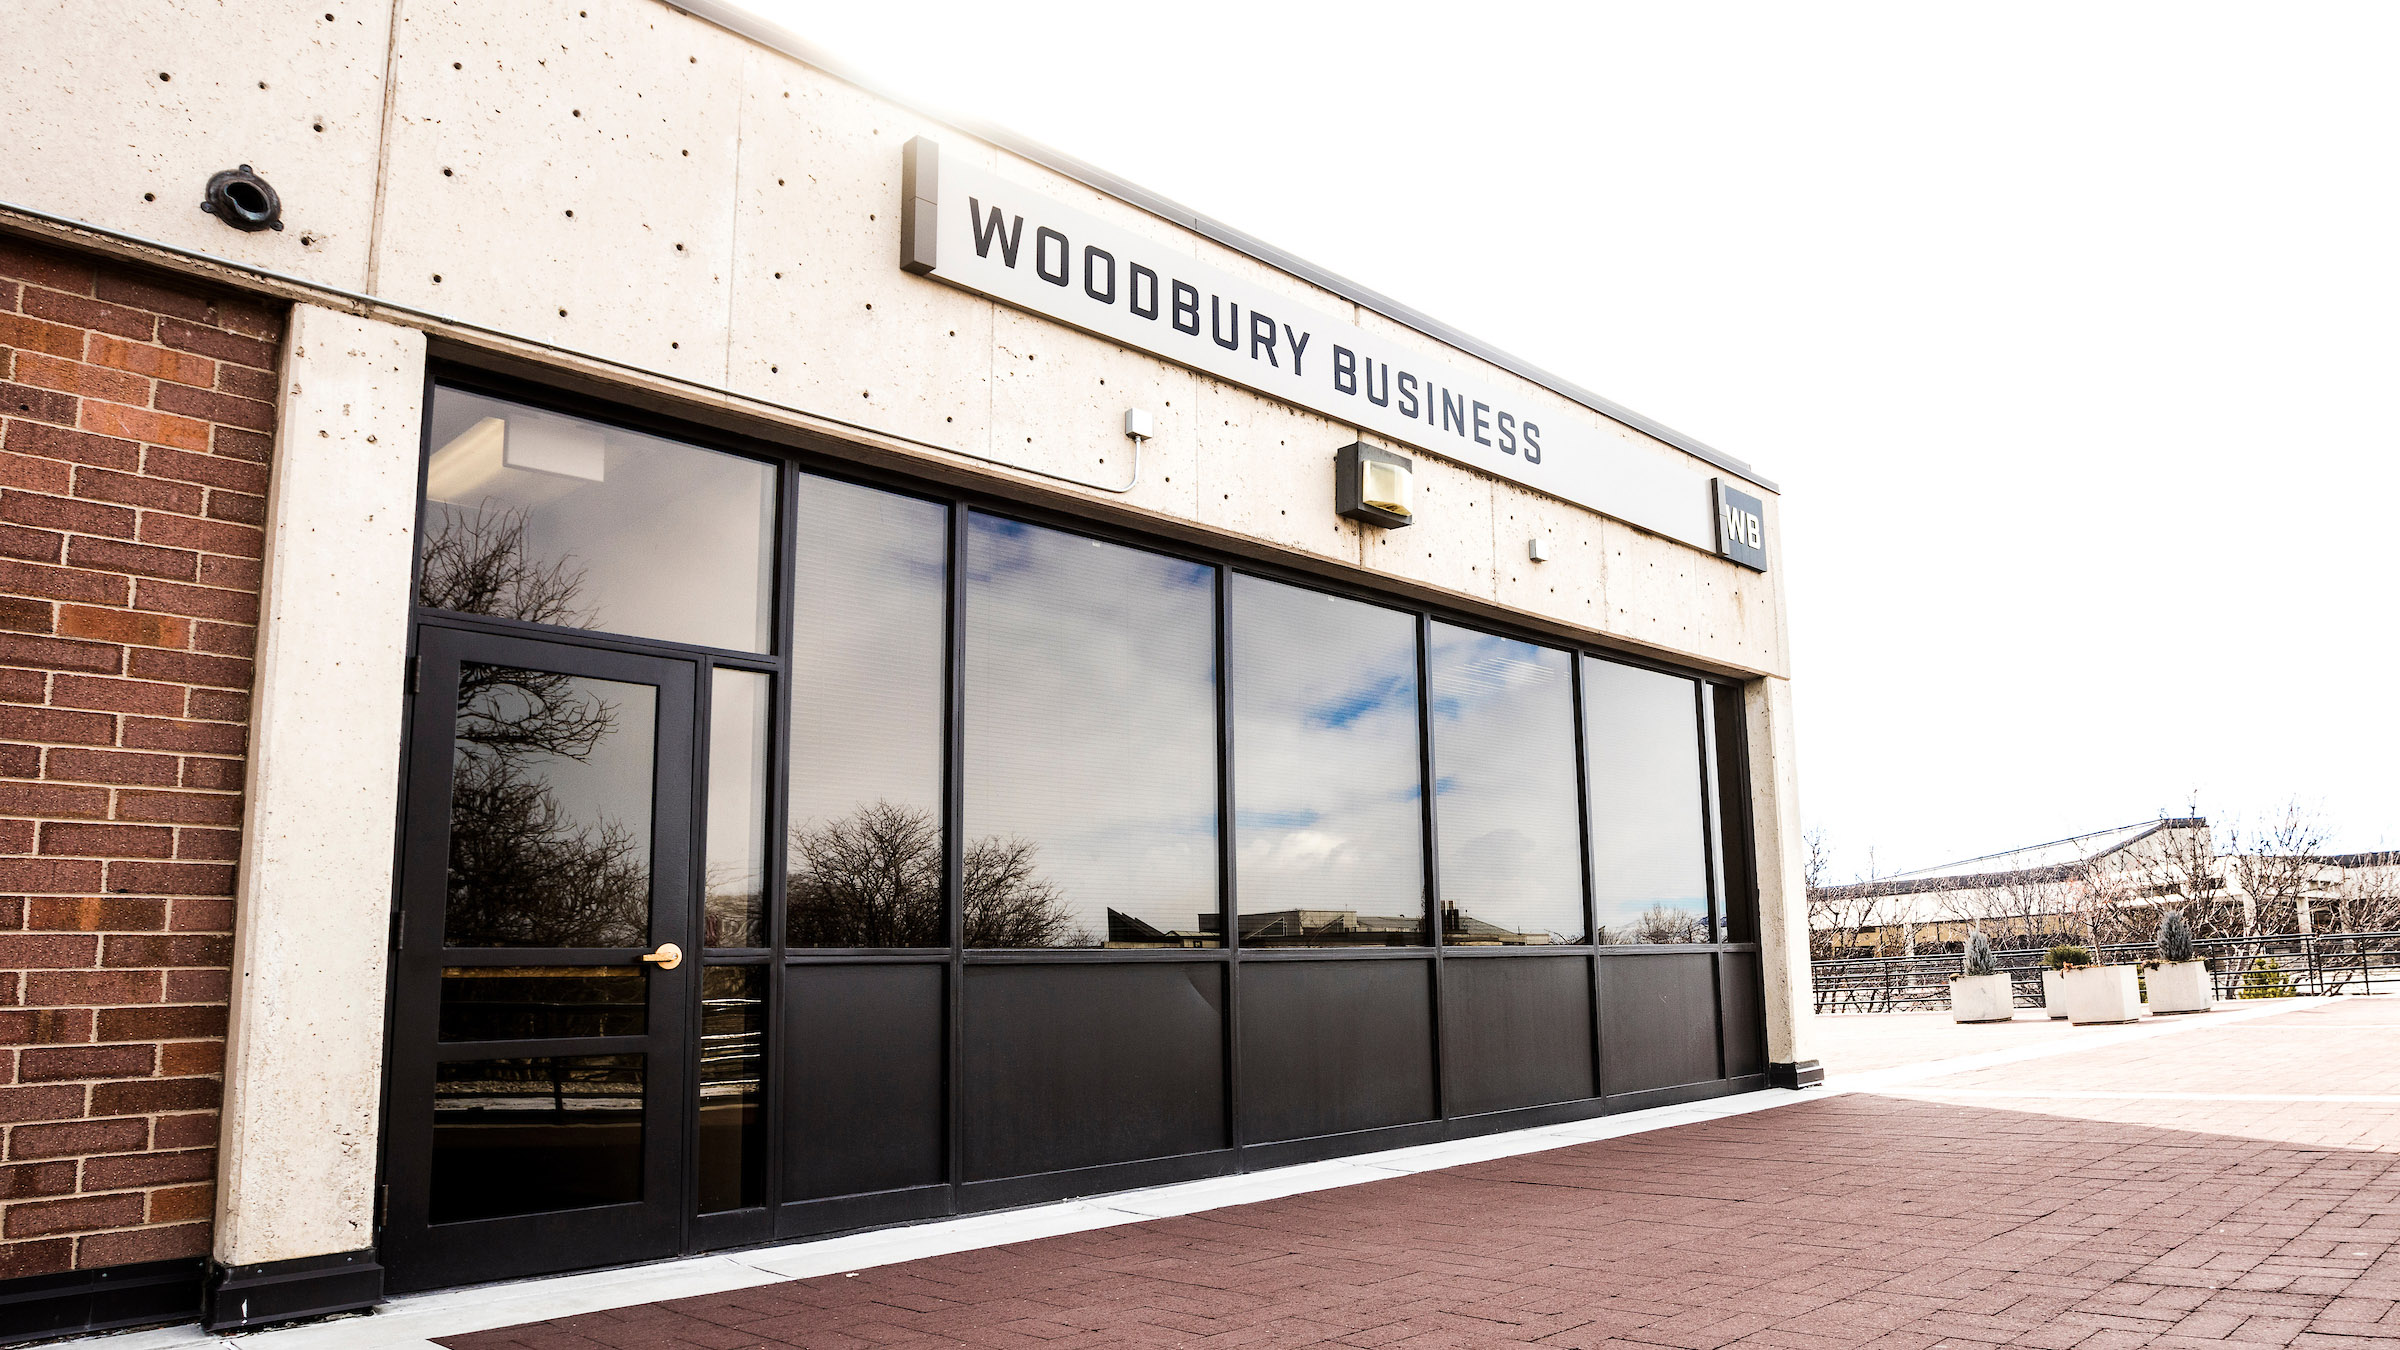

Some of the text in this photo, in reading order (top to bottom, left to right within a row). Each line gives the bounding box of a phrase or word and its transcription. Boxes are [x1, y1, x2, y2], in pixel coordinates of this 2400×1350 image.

[968, 196, 1542, 465] WOODBURY BUSINESS
[1725, 503, 1761, 550] WB
